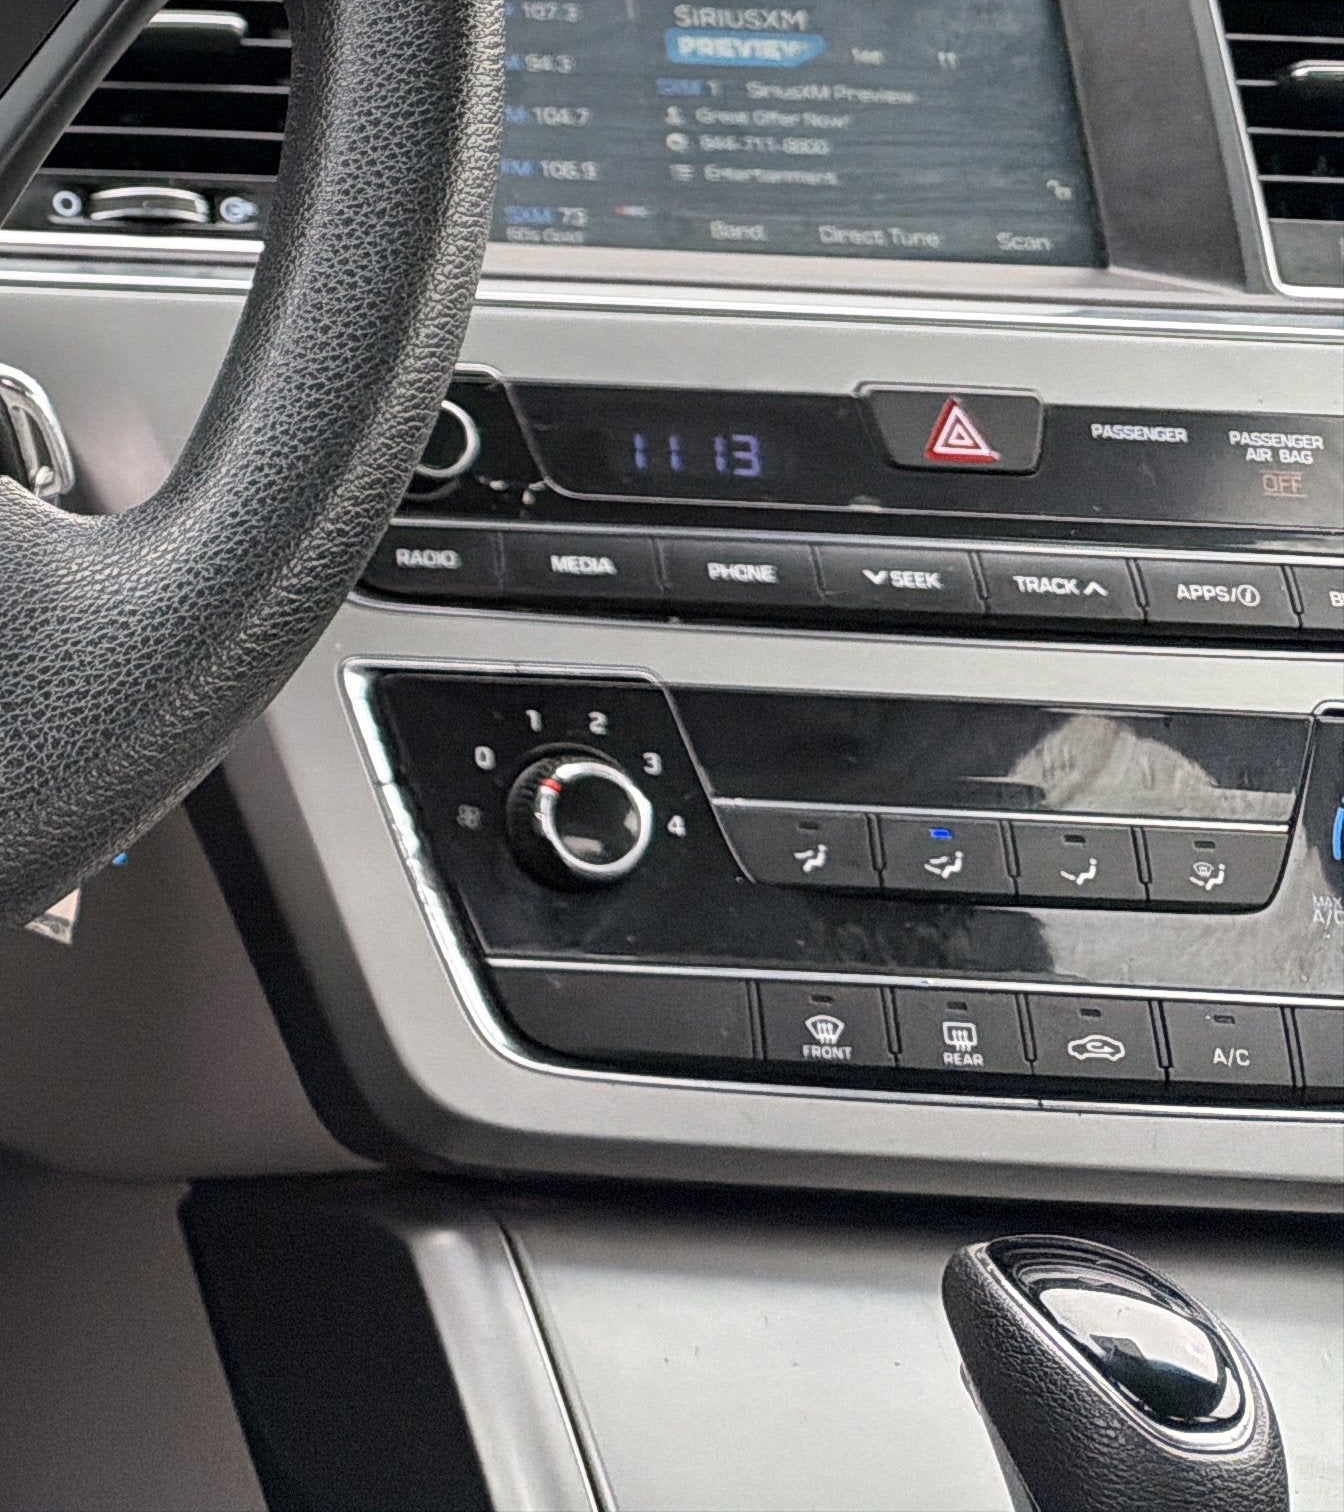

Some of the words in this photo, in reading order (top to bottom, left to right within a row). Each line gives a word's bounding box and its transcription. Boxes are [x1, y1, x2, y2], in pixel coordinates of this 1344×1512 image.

[887, 227, 940, 249] Tune
[996, 232, 1053, 252] Scan
[1091, 423, 1188, 443] PASSENGER
[1228, 430, 1324, 450] PASSENGER
[1246, 448, 1273, 463] AIR
[1279, 449, 1314, 465] BAG
[1263, 473, 1304, 493] OFF
[396, 548, 461, 569] RADIO
[550, 554, 617, 575] MEDIA
[707, 562, 778, 584] PHONE
[889, 570, 944, 589] SEEK
[1013, 575, 1080, 595] TRACK
[525, 709, 542, 732] 1
[588, 711, 608, 735] 2
[474, 745, 496, 770] 0
[642, 751, 662, 776] 3
[667, 815, 687, 837] 4
[1313, 895, 1343, 909] MAX
[802, 1044, 852, 1060] FRONT
[943, 1052, 984, 1067] REAR
[1214, 1046, 1250, 1068] A/C
